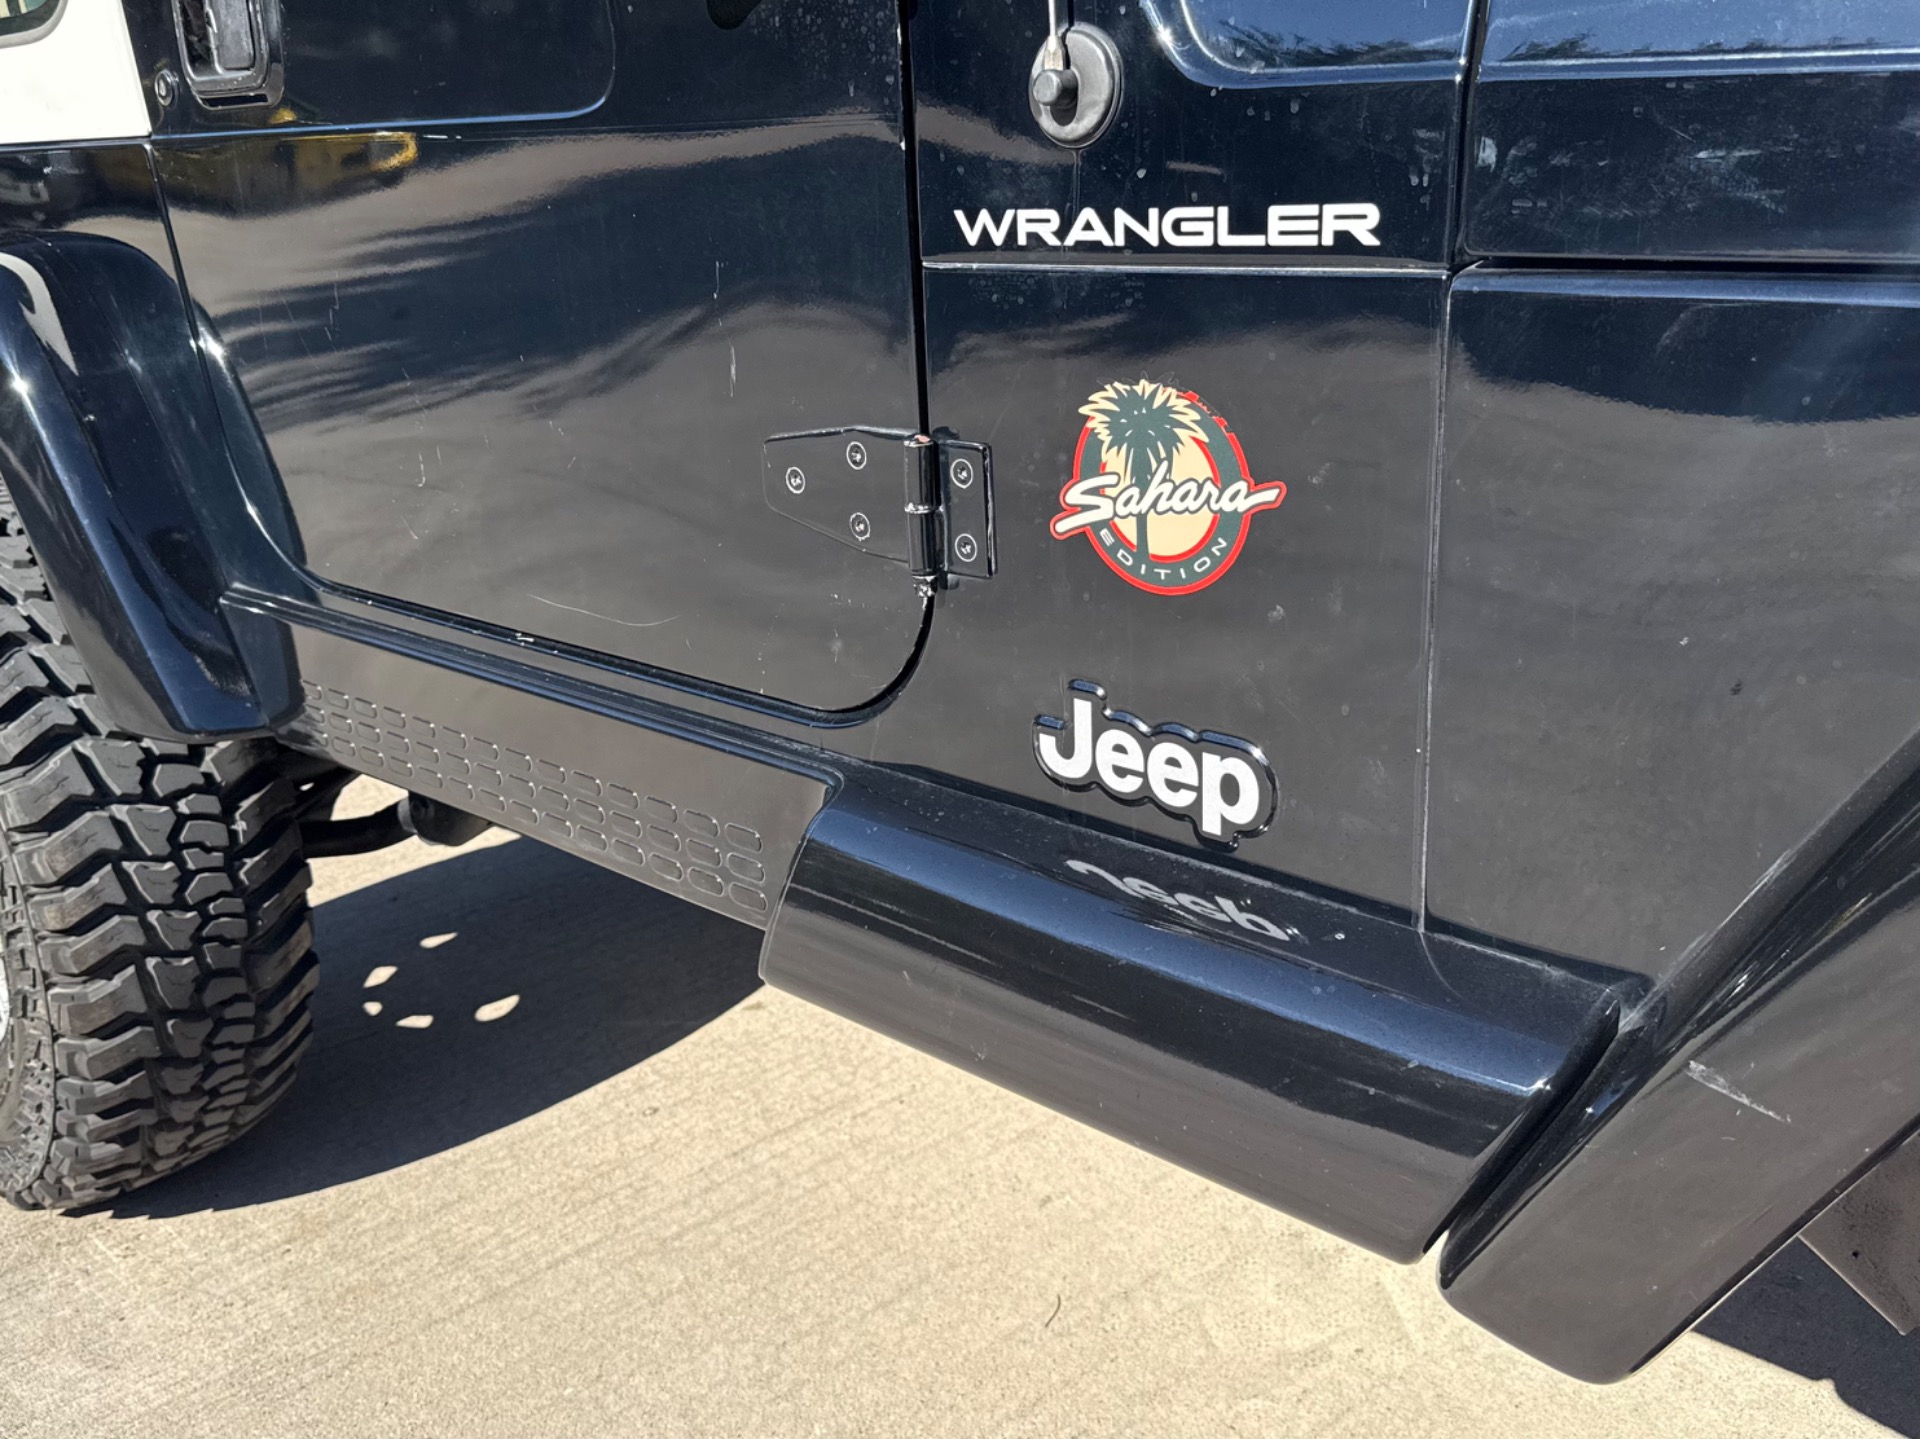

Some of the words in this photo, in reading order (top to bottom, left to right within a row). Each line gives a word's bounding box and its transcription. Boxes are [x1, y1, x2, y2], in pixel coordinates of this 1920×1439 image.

[953, 202, 1381, 247] WRANGLER
[1054, 459, 1280, 534] Sahara
[1099, 527, 1228, 580] EDITION
[1038, 697, 1260, 836] Jeep
